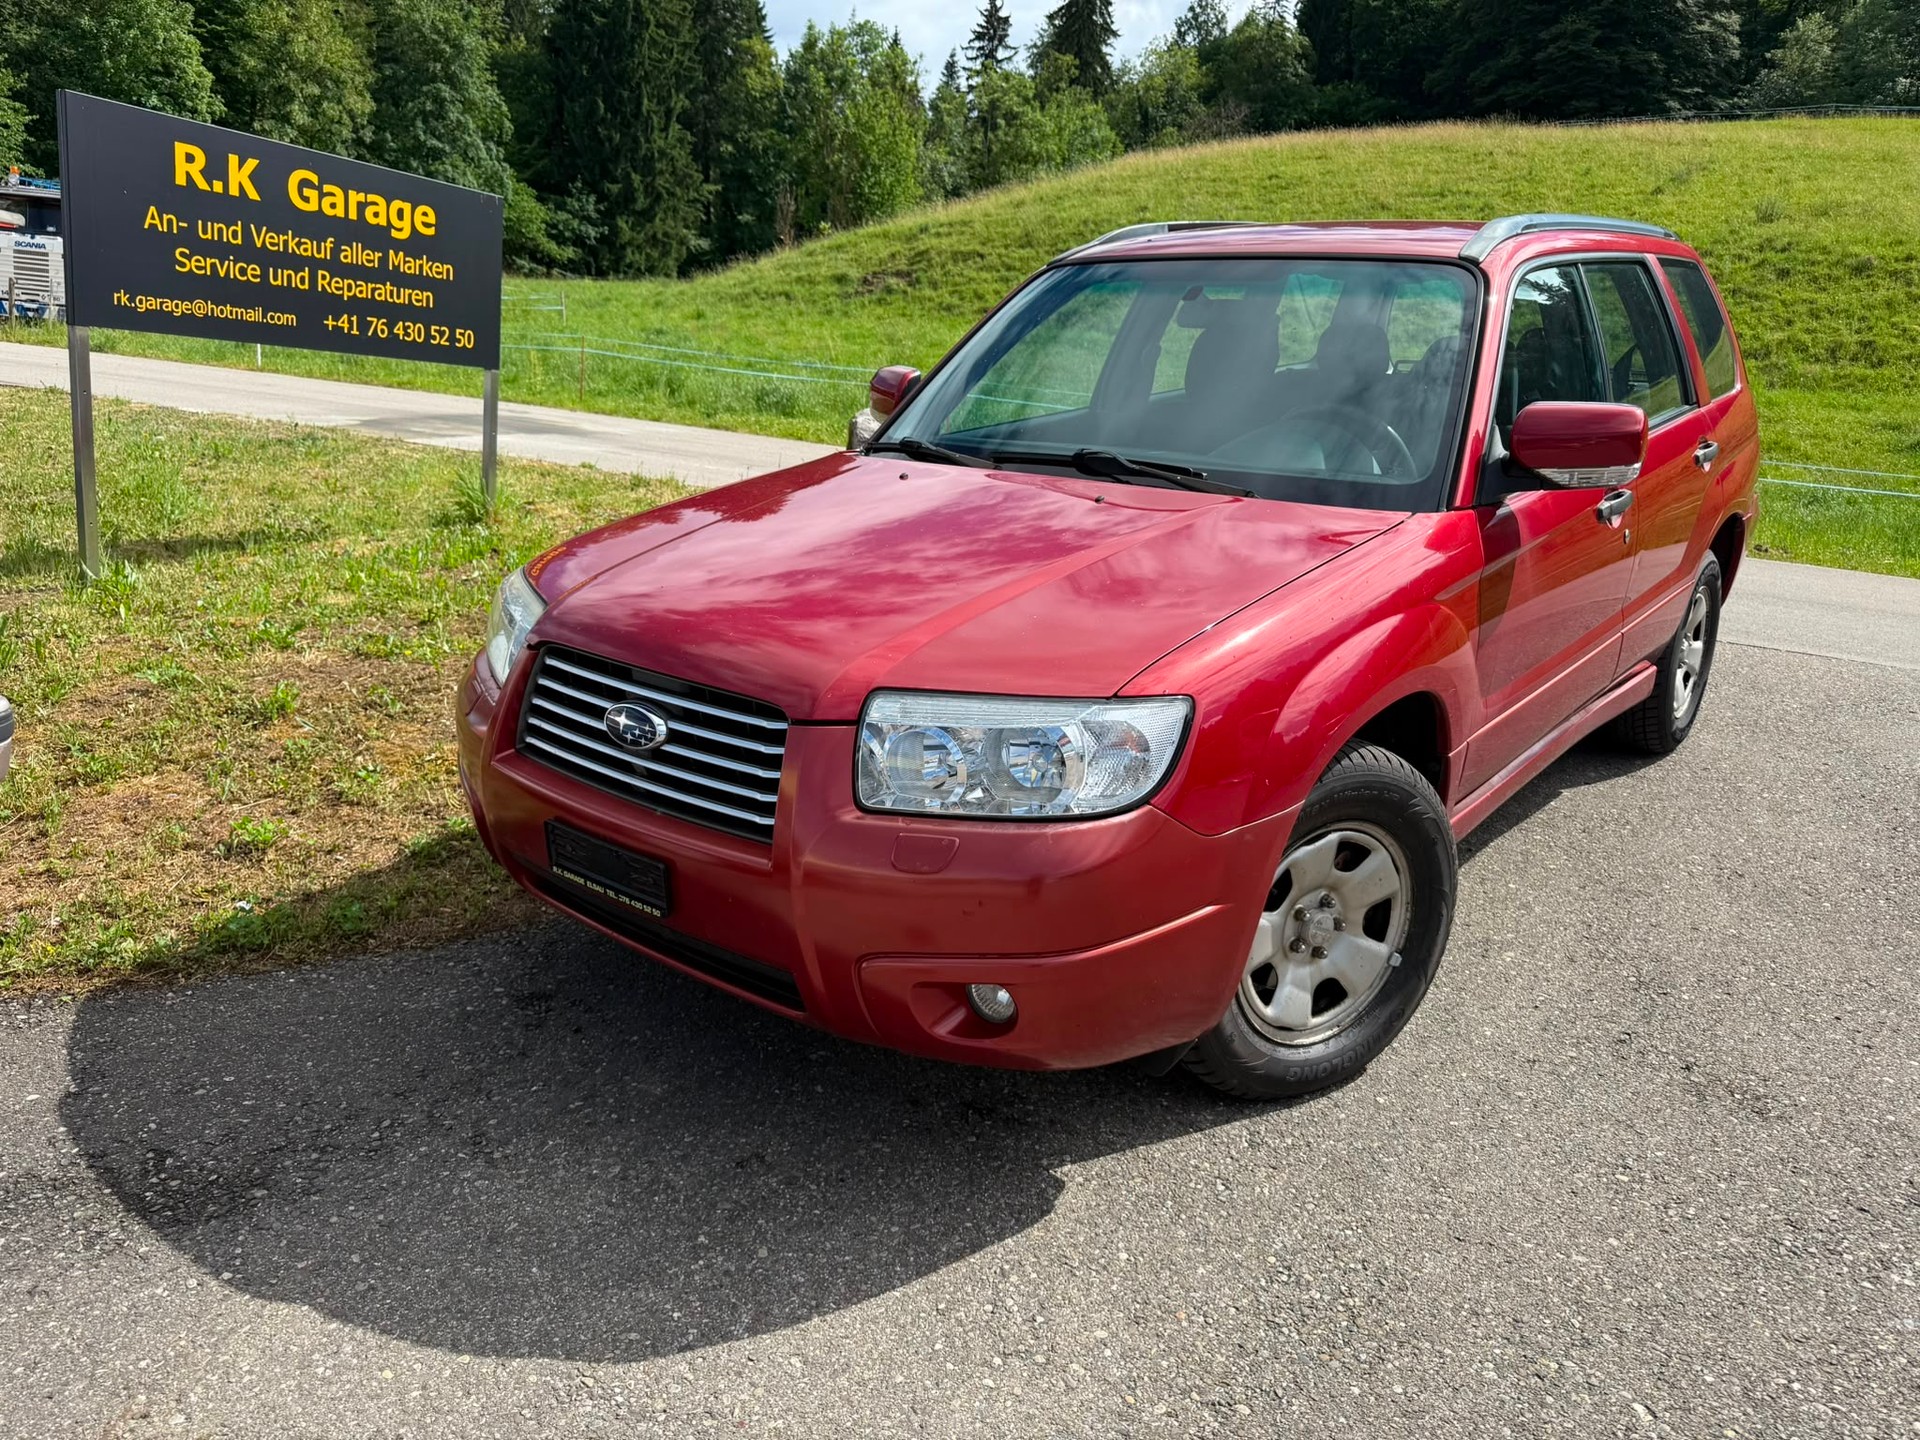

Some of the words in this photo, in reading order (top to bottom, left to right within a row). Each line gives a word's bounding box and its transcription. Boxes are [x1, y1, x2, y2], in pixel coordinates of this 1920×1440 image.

[174, 141, 261, 201] R.K
[287, 169, 437, 240] Garage
[14, 240, 47, 250] SCANIA
[143, 205, 189, 234] An-
[197, 217, 243, 246] und
[250, 223, 335, 260] Verkauf
[339, 241, 383, 269] aller
[388, 249, 454, 281] Marken
[174, 247, 262, 283] Service
[268, 264, 310, 290] und
[317, 269, 434, 309] Reparaturen
[113, 289, 297, 327] rk.garage@hotmail.com
[323, 313, 360, 336] +41
[366, 316, 388, 339] 76
[393, 320, 425, 343] 430
[430, 324, 450, 346] 52
[455, 328, 475, 349] 50
[563, 870, 585, 886] GARAGE
[586, 880, 604, 893] ELSAU
[630, 900, 643, 910] 430
[643, 904, 652, 914] 52
[652, 908, 661, 917] 50
